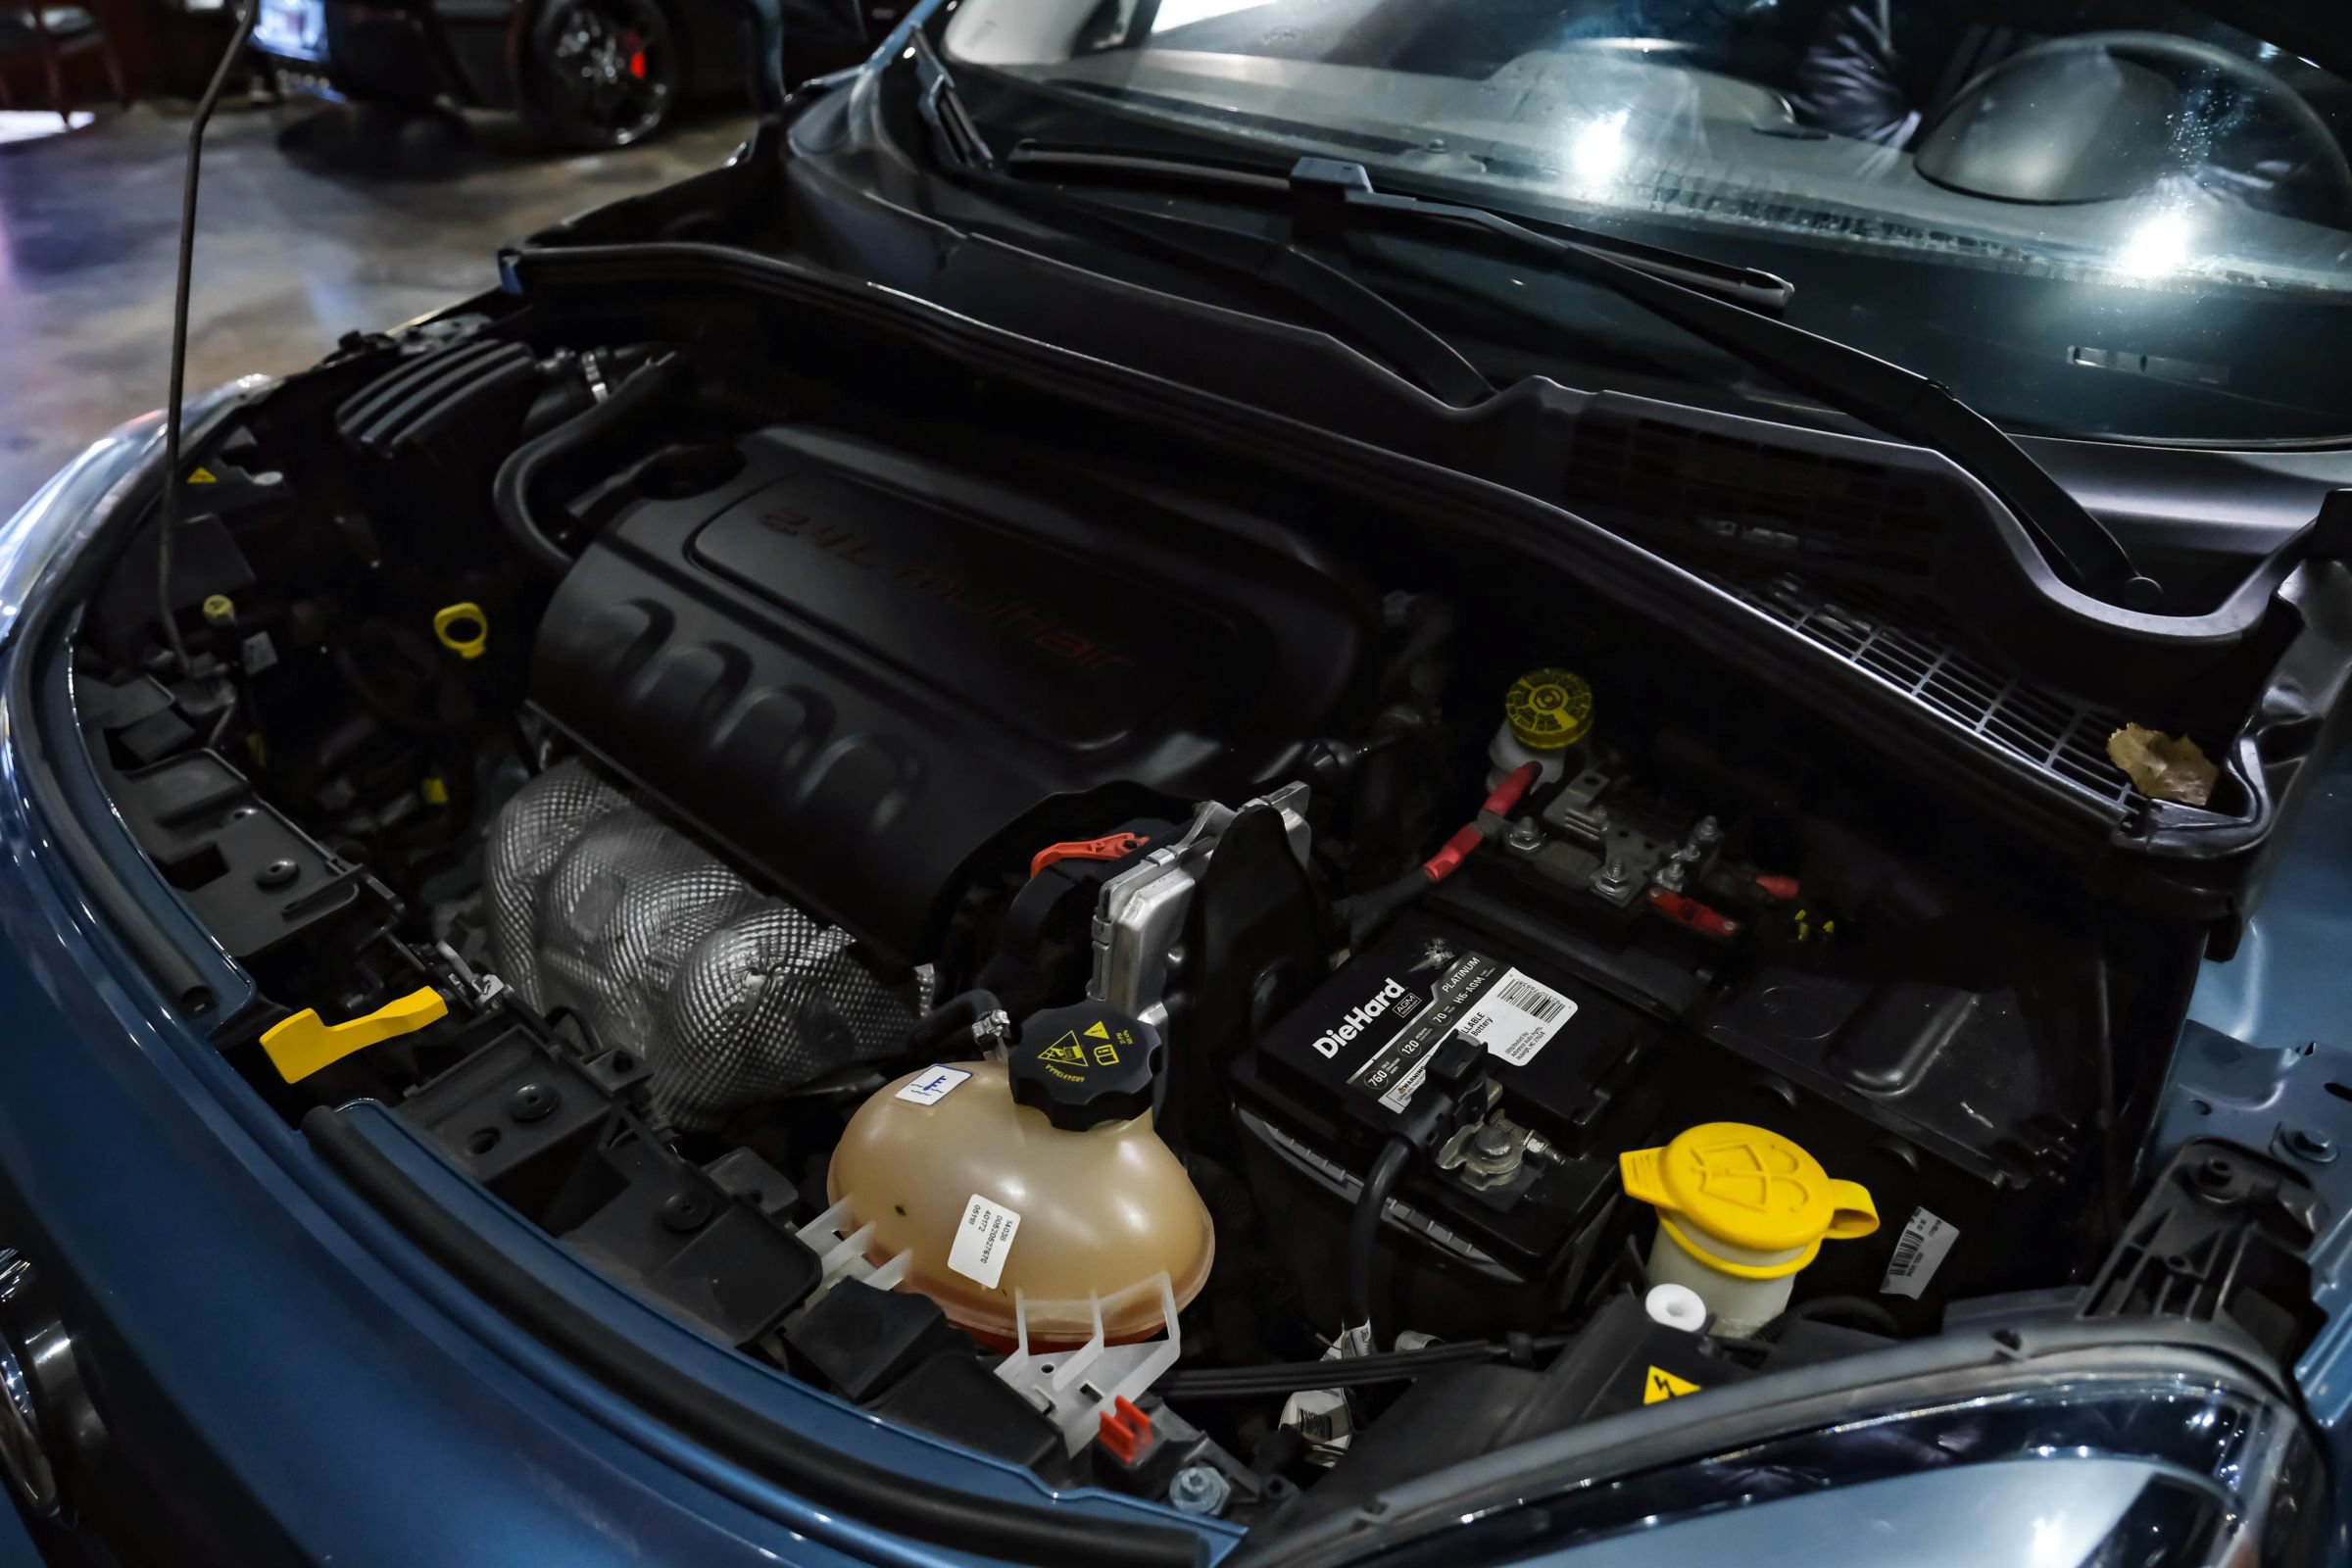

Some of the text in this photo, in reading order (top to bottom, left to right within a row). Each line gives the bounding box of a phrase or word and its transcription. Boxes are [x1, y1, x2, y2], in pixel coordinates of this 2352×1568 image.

[1442, 957, 1480, 993] PLATINUM
[1453, 976, 1485, 1004] H6-AGM
[1396, 995, 1415, 1011] AGM
[1312, 977, 1405, 1058] DieHard
[1433, 1012, 1447, 1023] 70
[1471, 1017, 1493, 1036] Battery
[1401, 1040, 1419, 1054] 120
[1368, 1070, 1388, 1087] 760
